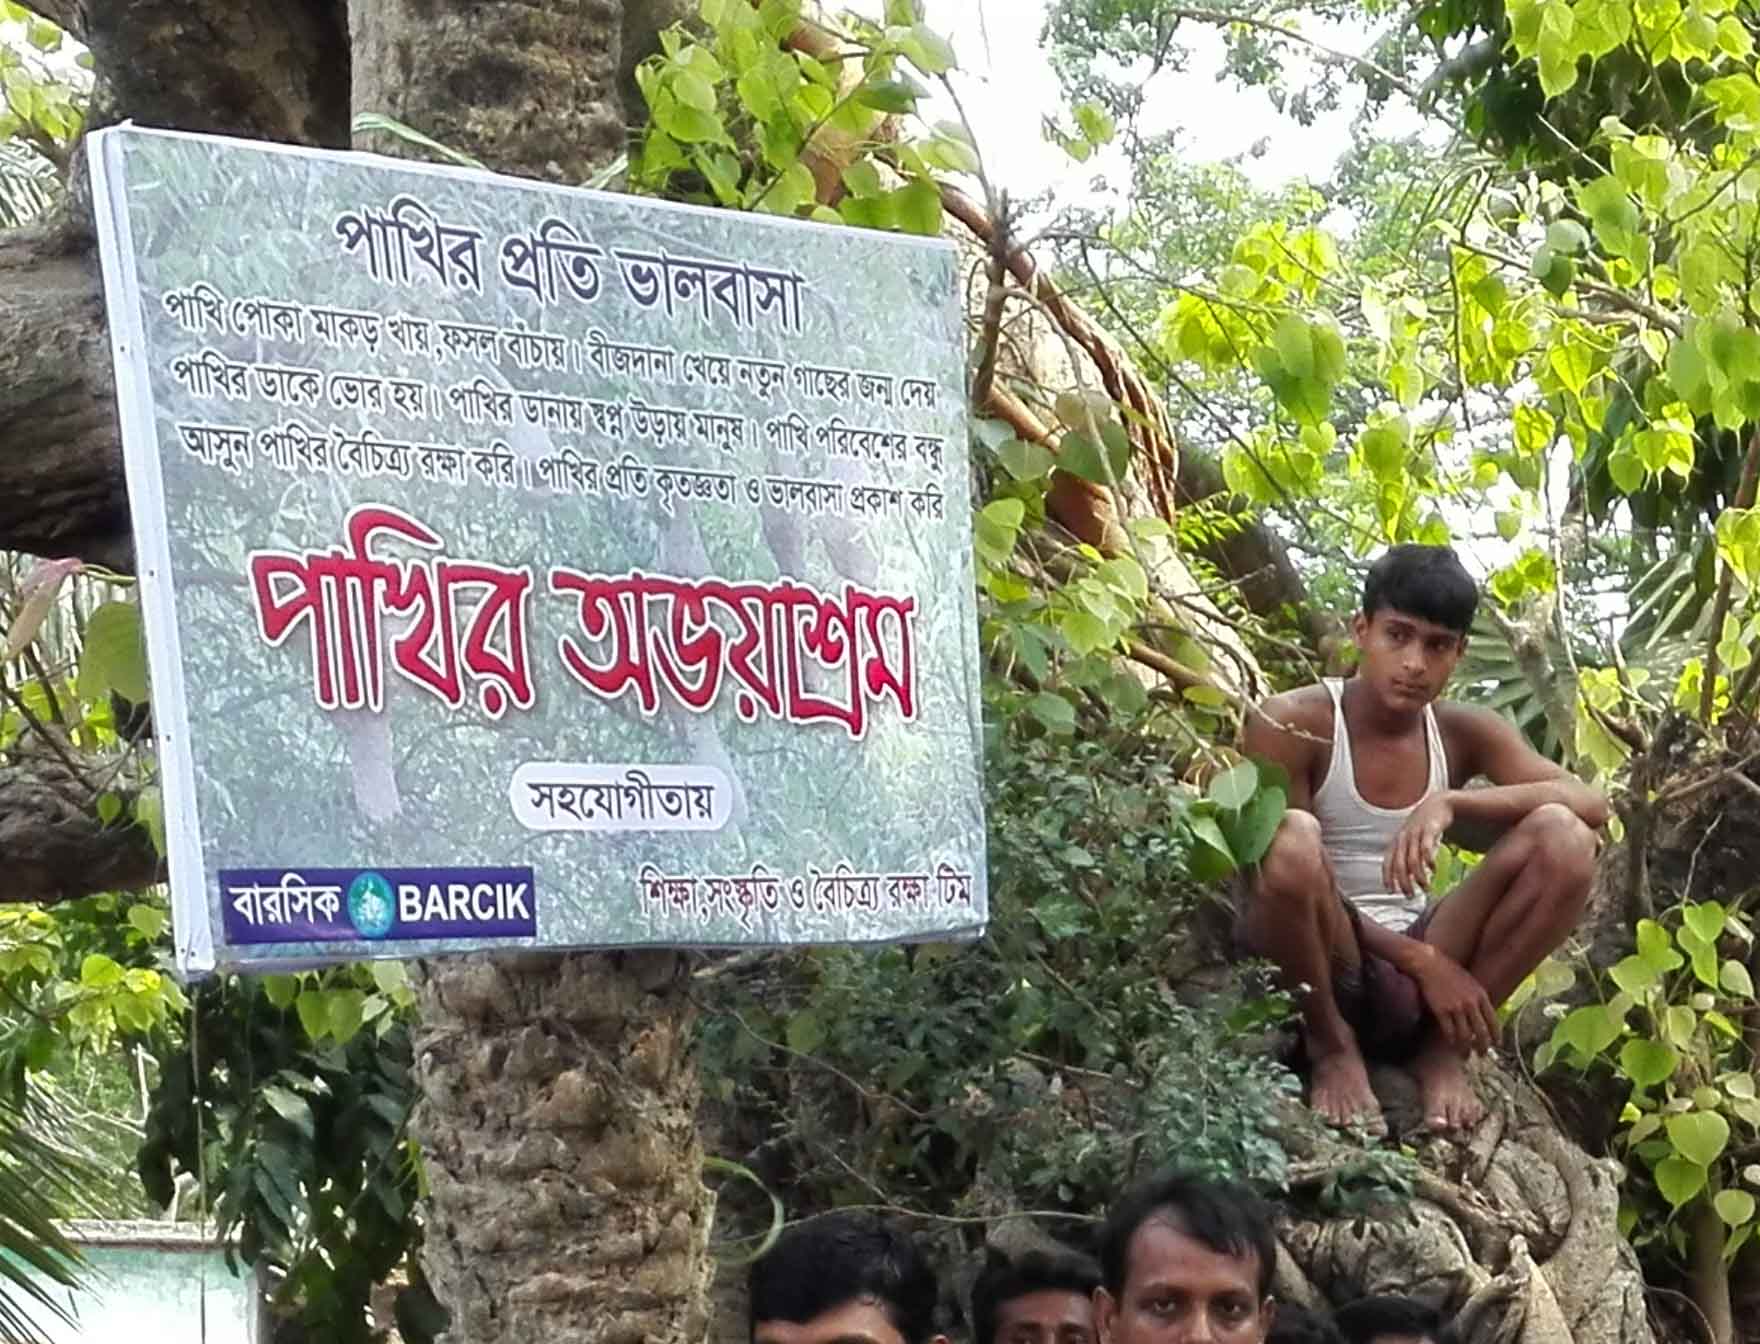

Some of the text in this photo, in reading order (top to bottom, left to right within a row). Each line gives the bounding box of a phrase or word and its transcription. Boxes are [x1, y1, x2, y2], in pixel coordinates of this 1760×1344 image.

[337, 195, 804, 331] পাখির প্রতি ভালবাসা
[165, 285, 224, 331] পাখি
[234, 300, 301, 340] পোকা
[311, 308, 379, 352] মাকড়
[505, 320, 566, 369] বাঁচায়
[588, 331, 675, 383] বীজদানা
[683, 354, 731, 386] খেয়ে
[737, 360, 785, 396] নতুন
[793, 364, 850, 400] গাছের
[856, 374, 893, 406] জন্ম
[902, 380, 936, 407] দেয়
[174, 352, 247, 397] পাখির
[256, 366, 320, 402] ডাকে
[332, 377, 381, 408] ভোর
[391, 380, 424, 414] হয়
[450, 379, 513, 423] পাখির
[521, 392, 583, 432] ডানায়
[588, 401, 624, 439] স্বপ্ন
[630, 396, 687, 444] উড়ায়
[692, 412, 744, 452] মানুষ
[767, 413, 809, 452] পাখি
[816, 417, 907, 460] পরিবেশের
[914, 436, 944, 471] বন্ধু
[178, 424, 249, 472] আসুন
[260, 424, 327, 469] পাখির
[335, 431, 410, 477] বৈচিত্র্য
[418, 446, 465, 481] রক্ষা
[472, 444, 515, 485] করি
[539, 449, 598, 491] পাখির
[605, 455, 648, 495] প্রতি
[654, 468, 736, 515] কৃতজ্ঞতা
[745, 479, 760, 504] ও
[767, 479, 843, 511] ভালবাসা
[851, 486, 903, 516] প্রকাশ
[908, 483, 944, 519] করি
[249, 506, 915, 736] পাখির অভয়াশ্রম
[528, 770, 713, 820] সহযোগীতায়
[229, 873, 341, 925] বারসিক
[399, 884, 530, 921] BARCIK
[788, 878, 804, 909] ও
[811, 863, 878, 911] বৈচিত্র্য
[887, 875, 930, 909] রক্ষা
[937, 863, 972, 906] টিম
